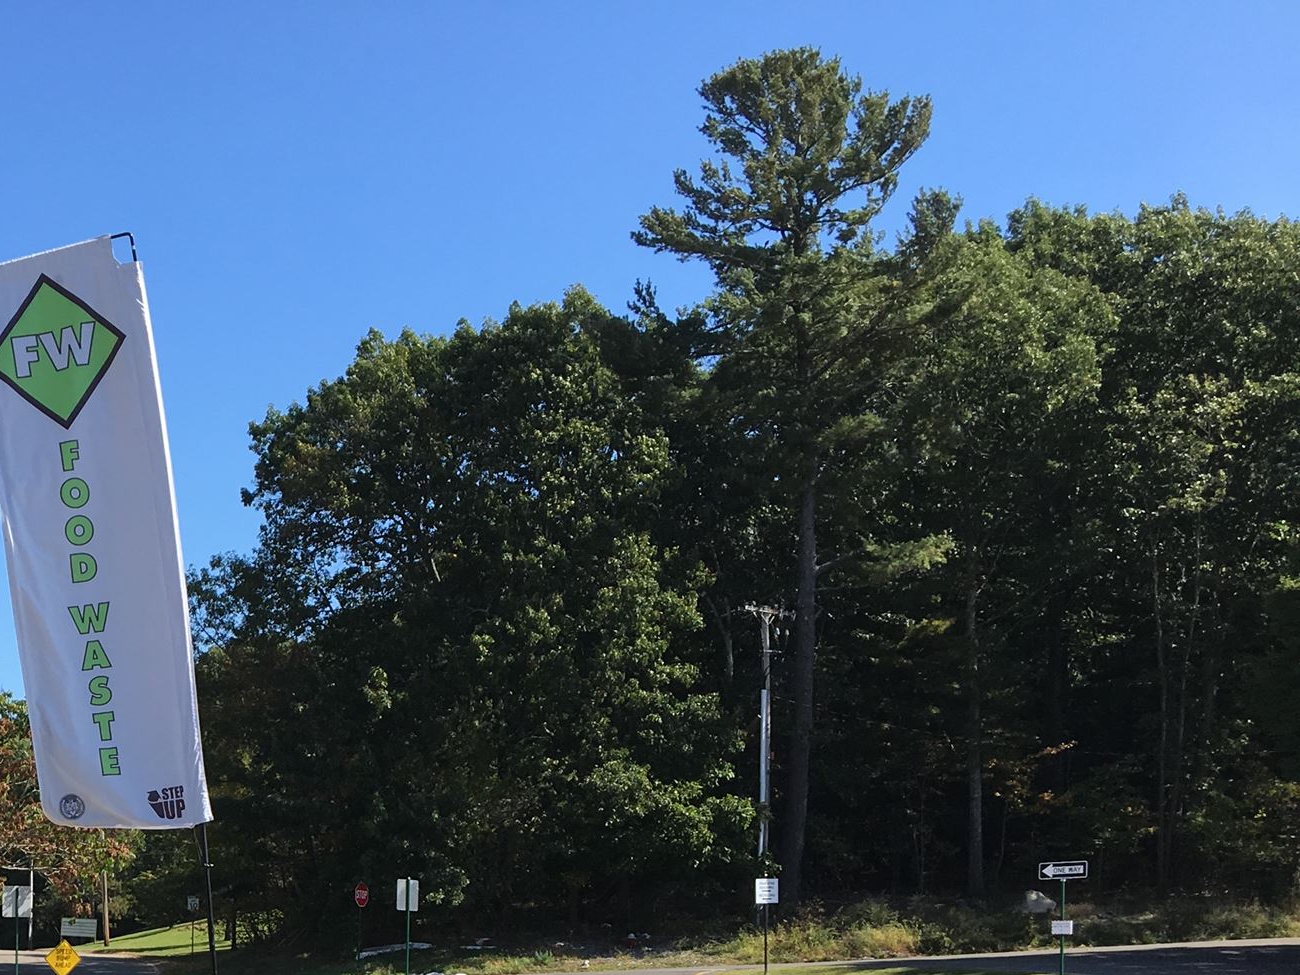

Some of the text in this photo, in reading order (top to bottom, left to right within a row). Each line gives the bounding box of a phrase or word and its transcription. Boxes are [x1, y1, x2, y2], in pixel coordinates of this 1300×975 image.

[10, 321, 96, 379] FW
[59, 439, 98, 584] FOOD
[68, 601, 122, 777] WASTE
[162, 785, 185, 800] STEP
[164, 799, 186, 820] UP
[356, 889, 369, 899] STOP
